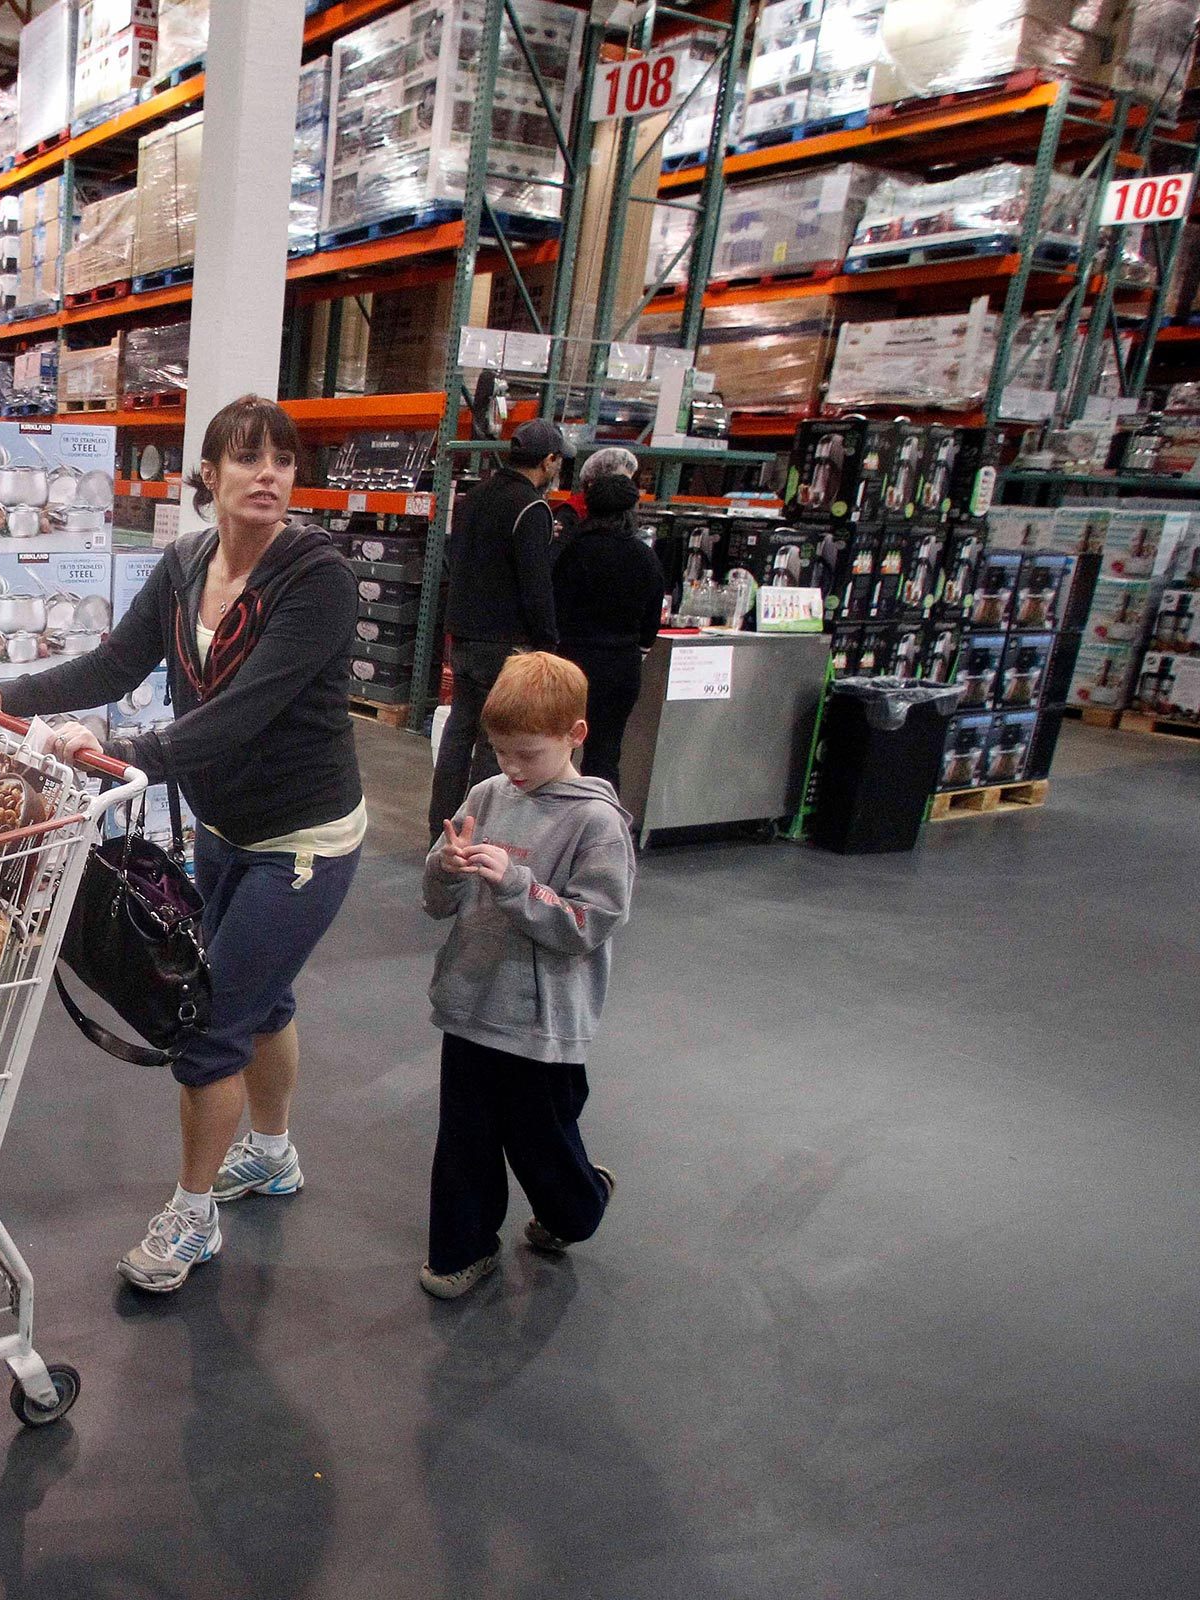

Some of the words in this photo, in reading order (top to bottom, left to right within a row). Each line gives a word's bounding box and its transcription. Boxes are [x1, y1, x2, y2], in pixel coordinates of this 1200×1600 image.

[606, 56, 675, 115] 108
[1115, 179, 1182, 221] 106
[72, 444, 97, 452] STEEL
[704, 684, 729, 695] 99.99
